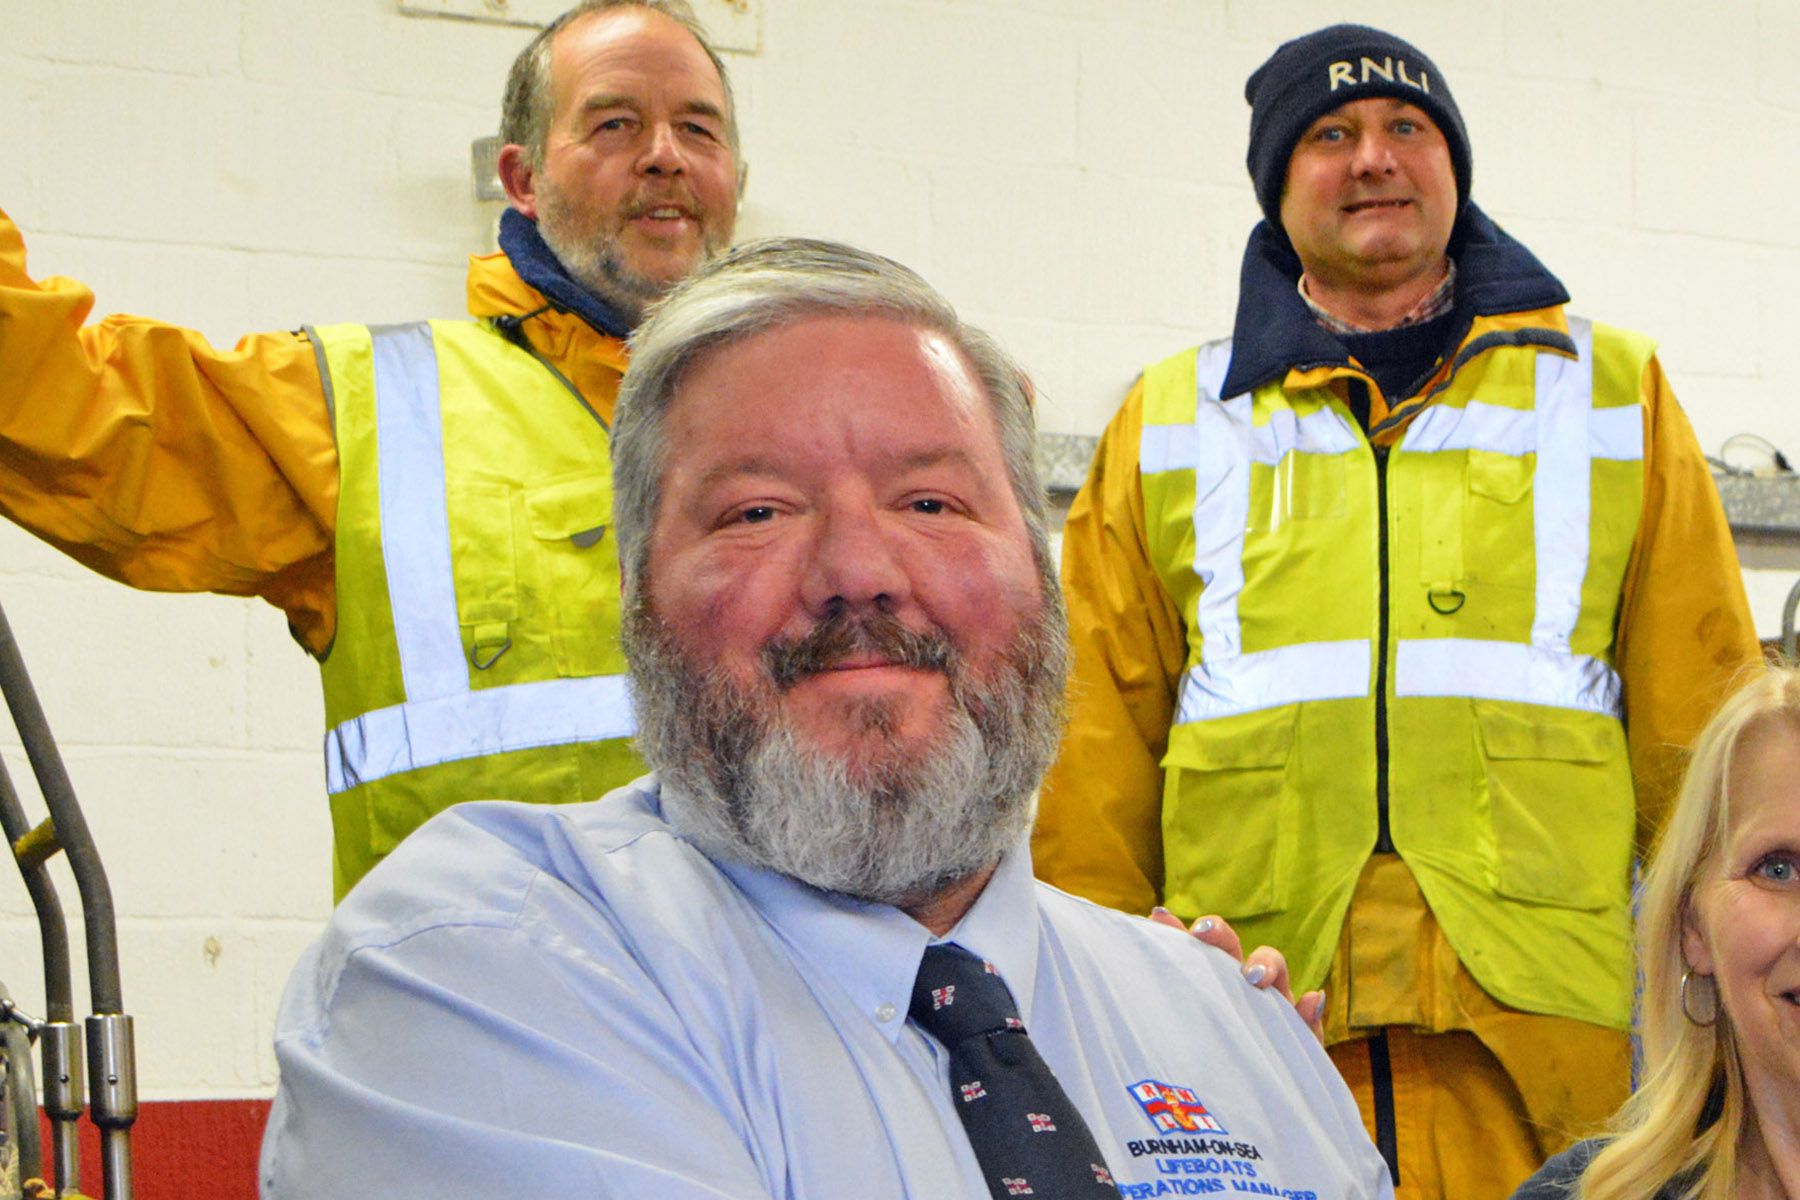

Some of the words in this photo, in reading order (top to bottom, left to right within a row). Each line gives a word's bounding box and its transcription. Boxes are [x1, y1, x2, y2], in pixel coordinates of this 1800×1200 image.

[1328, 56, 1429, 94] RNLI
[1126, 1138, 1263, 1160] BURNHAM-ON-SEA
[1154, 1158, 1258, 1178] LIFEBOATS
[1117, 1178, 1227, 1200] PERATIONS
